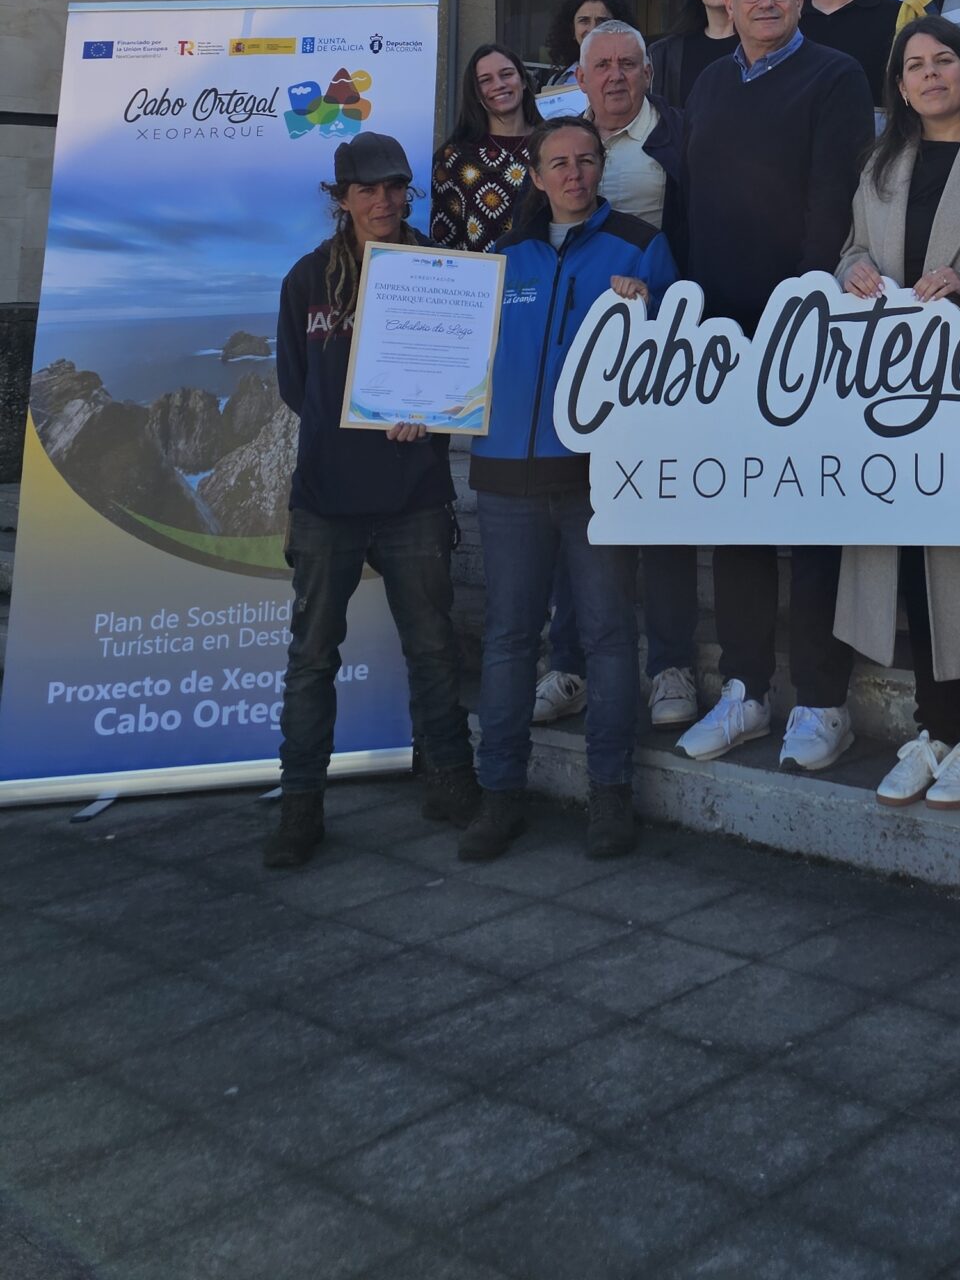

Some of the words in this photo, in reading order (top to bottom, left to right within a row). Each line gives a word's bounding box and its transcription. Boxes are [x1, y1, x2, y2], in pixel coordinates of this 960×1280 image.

[317, 37, 347, 45] XUNTA
[332, 44, 364, 52] GALICIA
[399, 45, 422, 53] CORUÑA
[124, 87, 187, 123] Cabo
[192, 86, 280, 124] Ortegal
[136, 125, 264, 140] XEOPARQUE
[374, 282, 411, 293] EMPRESA
[412, 285, 476, 298] COLABORADORA
[477, 291, 490, 299] DO
[376, 292, 423, 303] XEOPARQUE
[448, 299, 484, 308] ORTEGAL
[568, 297, 740, 436] Cabo
[95, 612, 142, 634] Plan
[150, 608, 180, 630] de
[187, 599, 292, 628] Sostibilid
[99, 634, 194, 658] Turística
[202, 631, 229, 651] en
[239, 626, 293, 648] Dest
[47, 676, 172, 704] Proxecto
[179, 670, 213, 694] de
[93, 704, 182, 737] Cabo
[193, 698, 285, 731] Orteg
